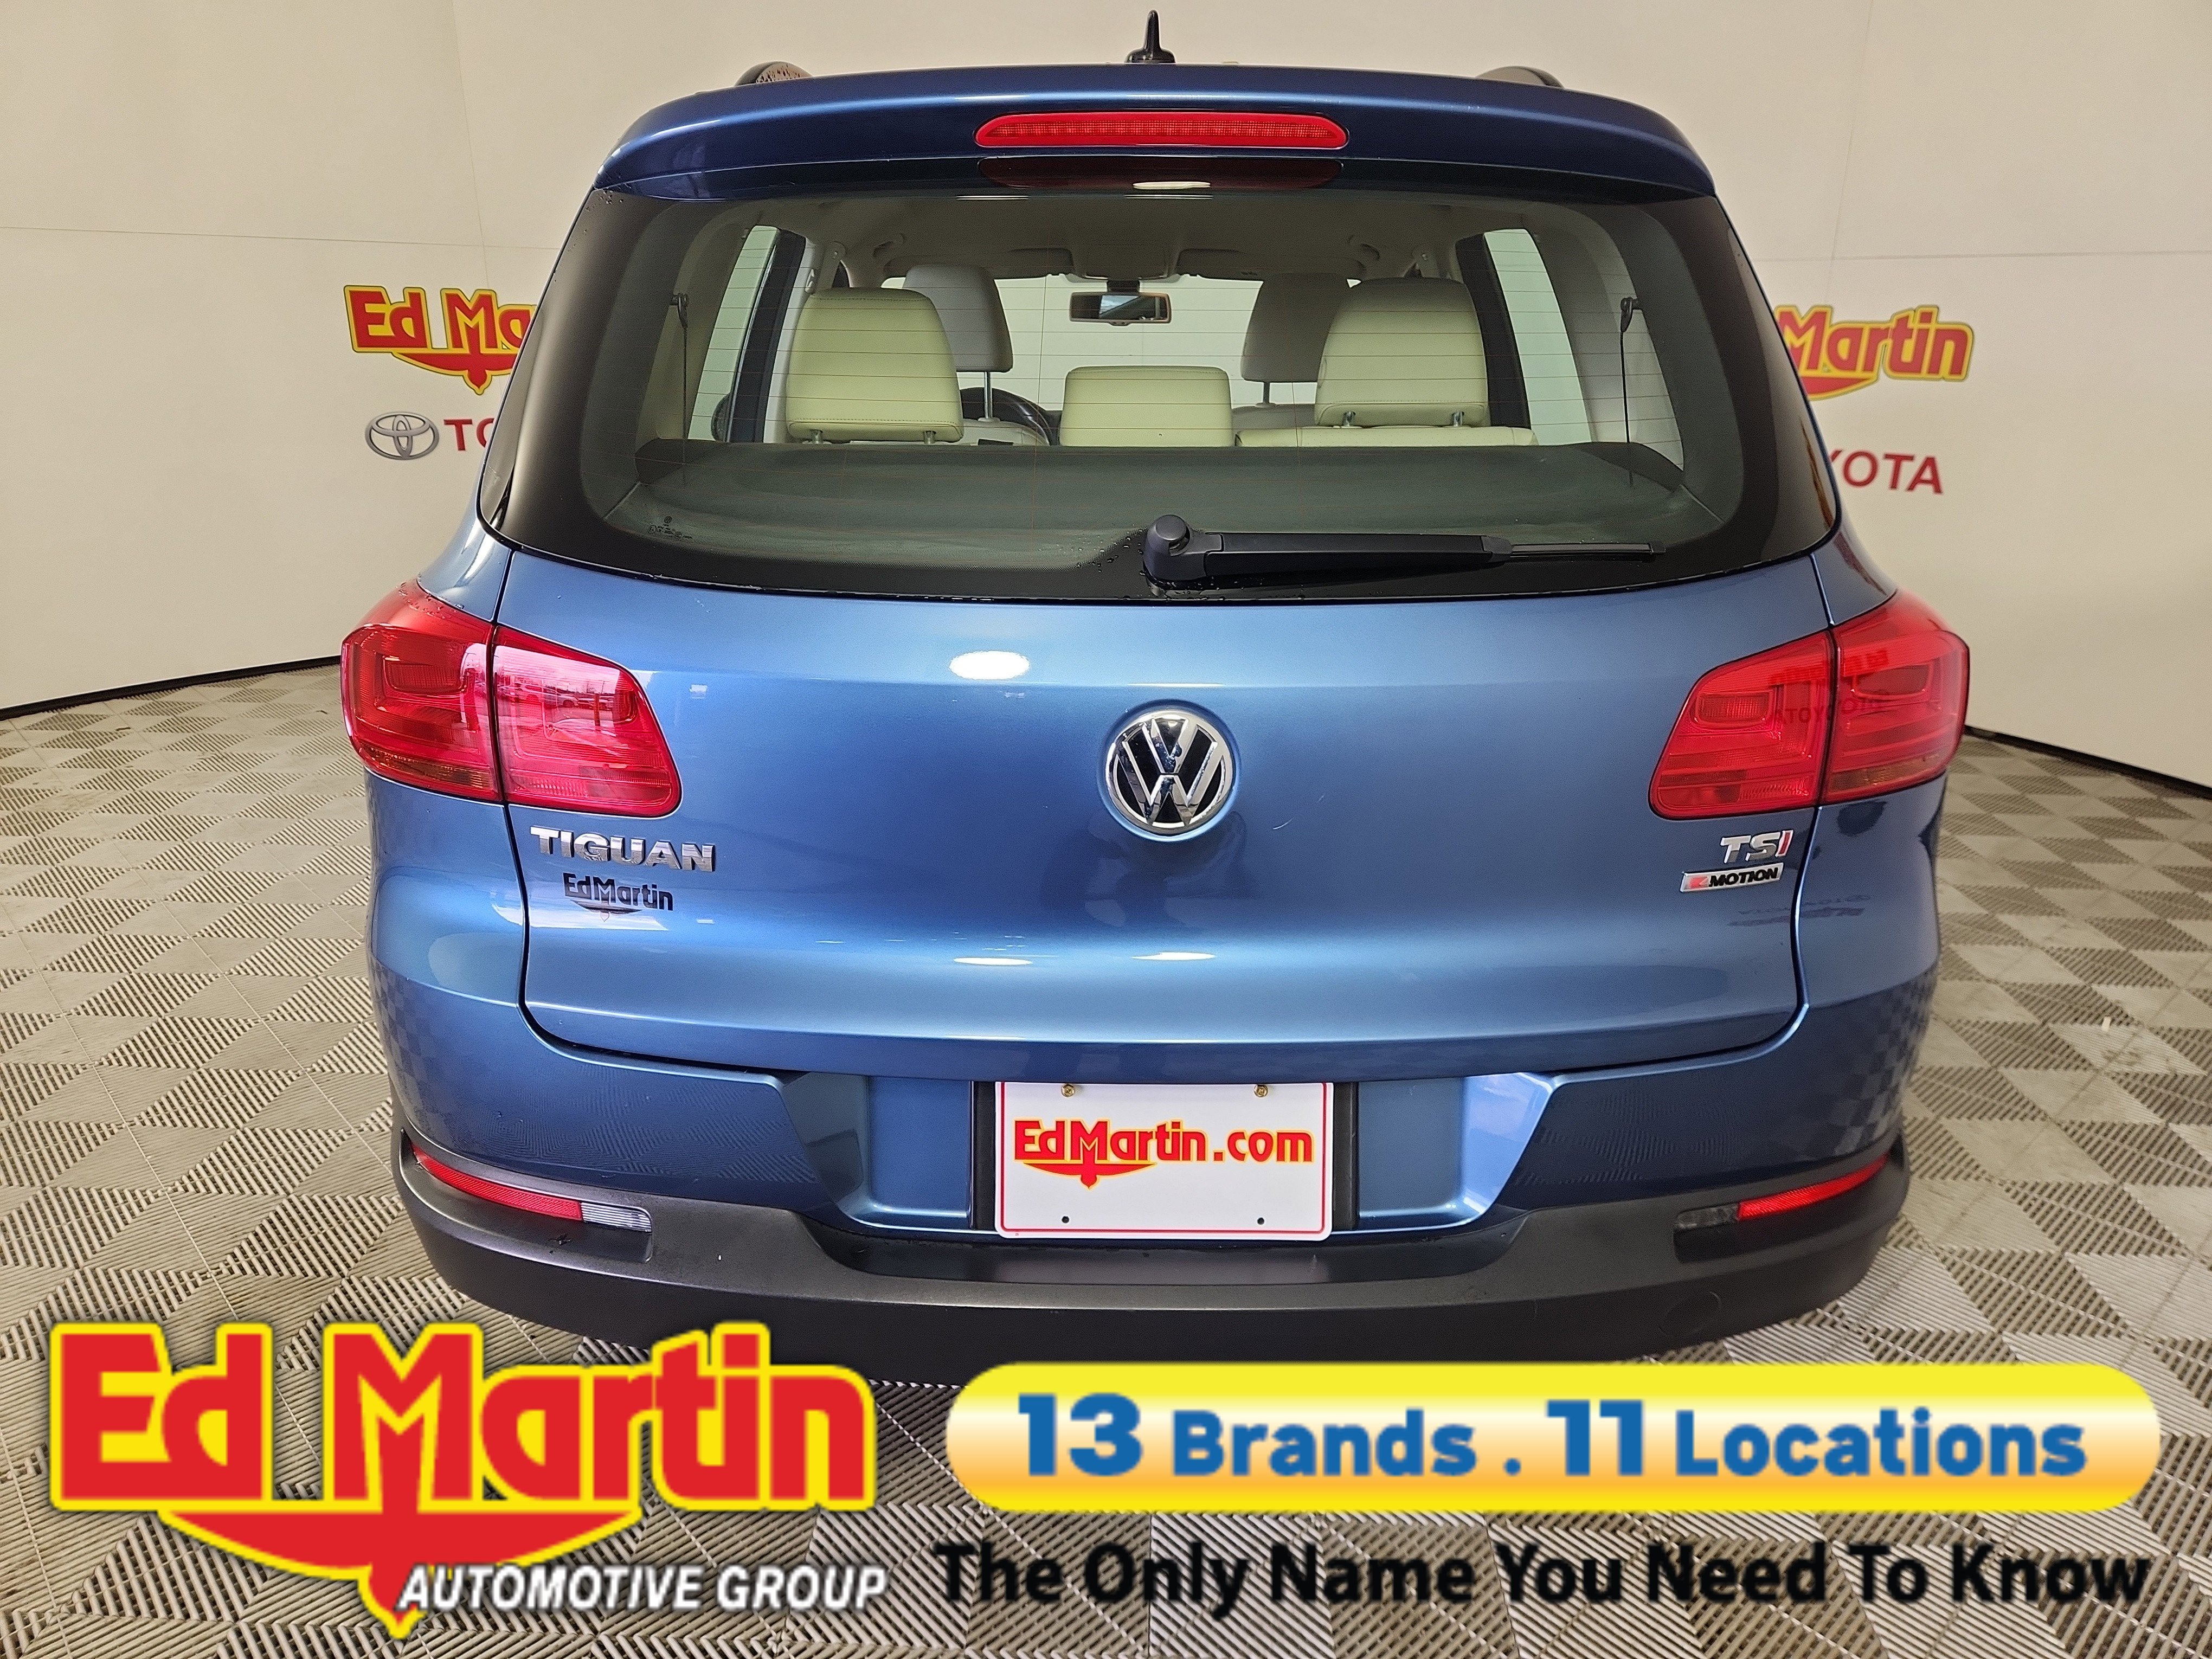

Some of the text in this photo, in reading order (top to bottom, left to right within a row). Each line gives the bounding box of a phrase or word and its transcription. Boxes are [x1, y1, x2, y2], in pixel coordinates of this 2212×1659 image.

[346, 287, 430, 351] Ed
[1775, 306, 1972, 379] Martin
[530, 826, 716, 872] TIGUAN
[1013, 1119, 1315, 1164] EdMartin.com
